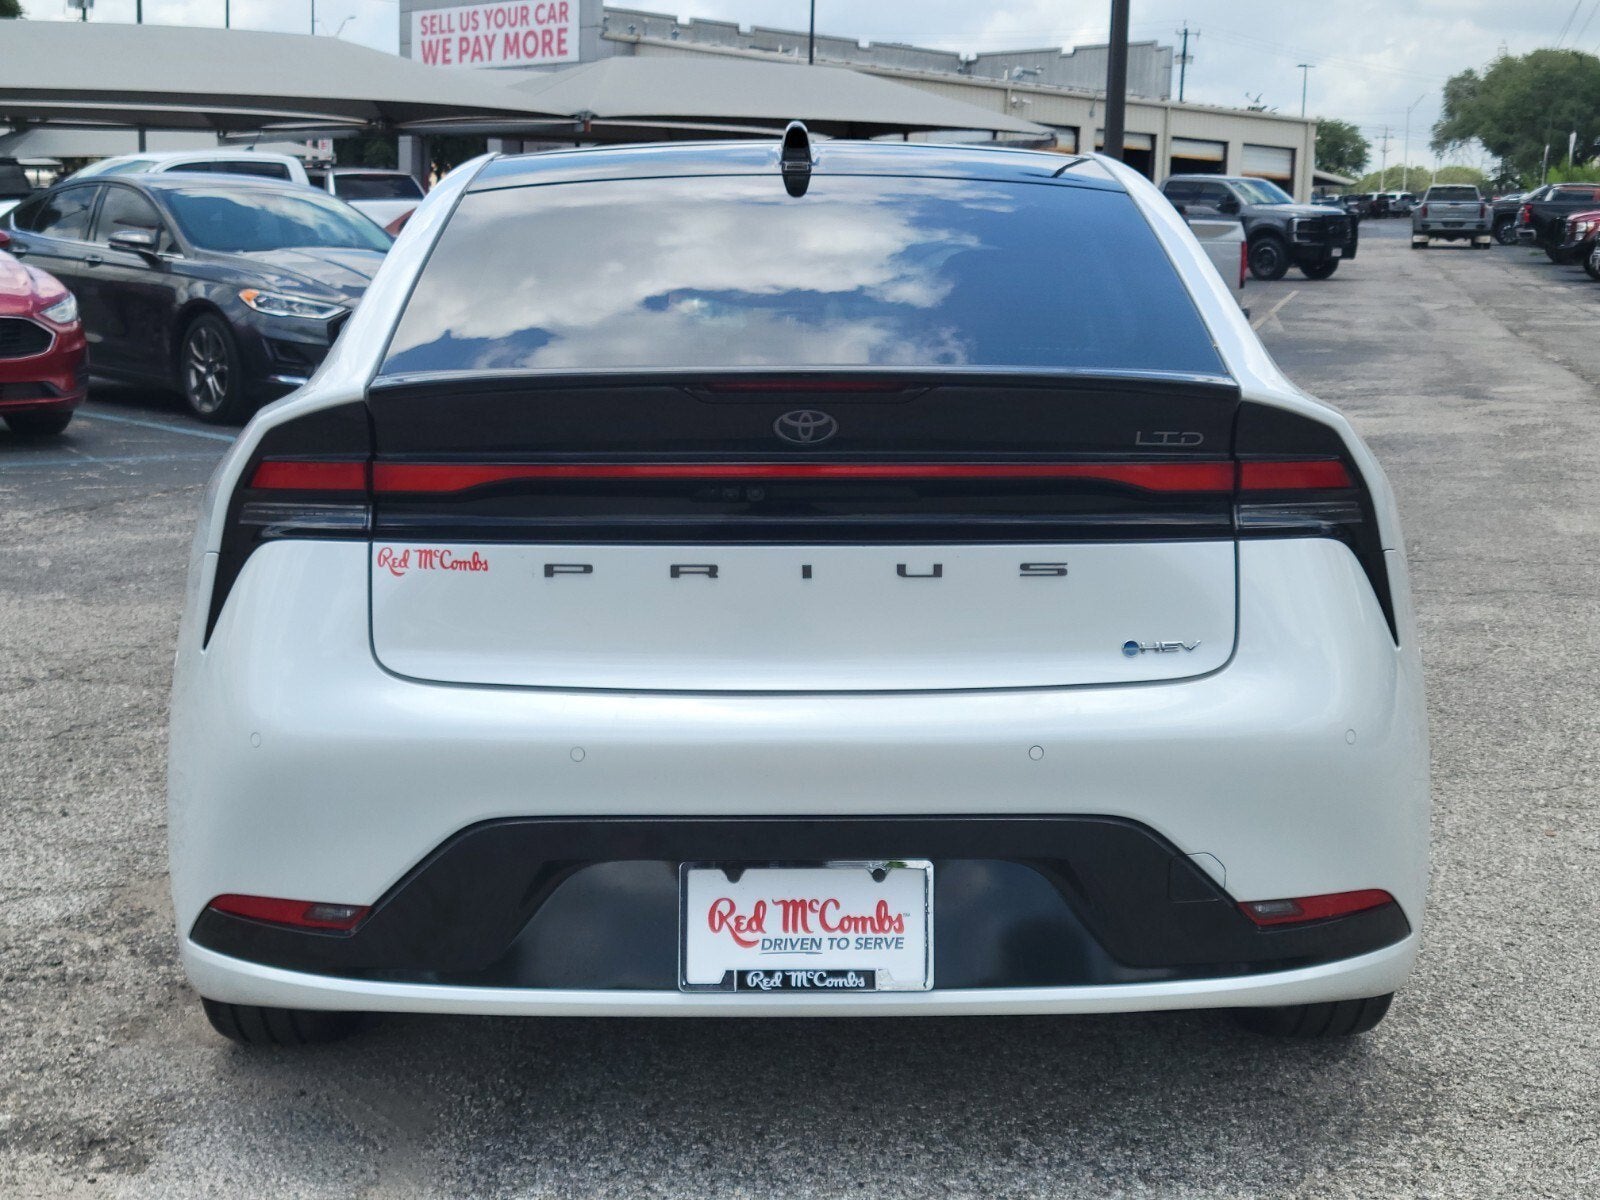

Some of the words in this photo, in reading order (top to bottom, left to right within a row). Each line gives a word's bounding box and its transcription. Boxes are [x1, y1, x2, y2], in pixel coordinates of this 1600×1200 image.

[420, 14, 455, 36] SELL
[459, 10, 479, 32] US
[483, 5, 530, 30] YOUR
[534, 1, 569, 25] CAR
[421, 38, 452, 66] WE
[458, 33, 497, 64] PAY
[503, 28, 568, 60] MORE
[1135, 431, 1204, 446] LTD
[377, 547, 410, 576] Red
[413, 548, 489, 572] McCombs
[544, 562, 1068, 580] PRIUS
[708, 897, 767, 949] Red
[772, 898, 905, 935] McCombs
[760, 938, 822, 951] DRIVEN
[828, 937, 850, 951] TO
[854, 937, 905, 951] SERVE
[746, 970, 783, 991] Red
[785, 971, 866, 989] McCombs
